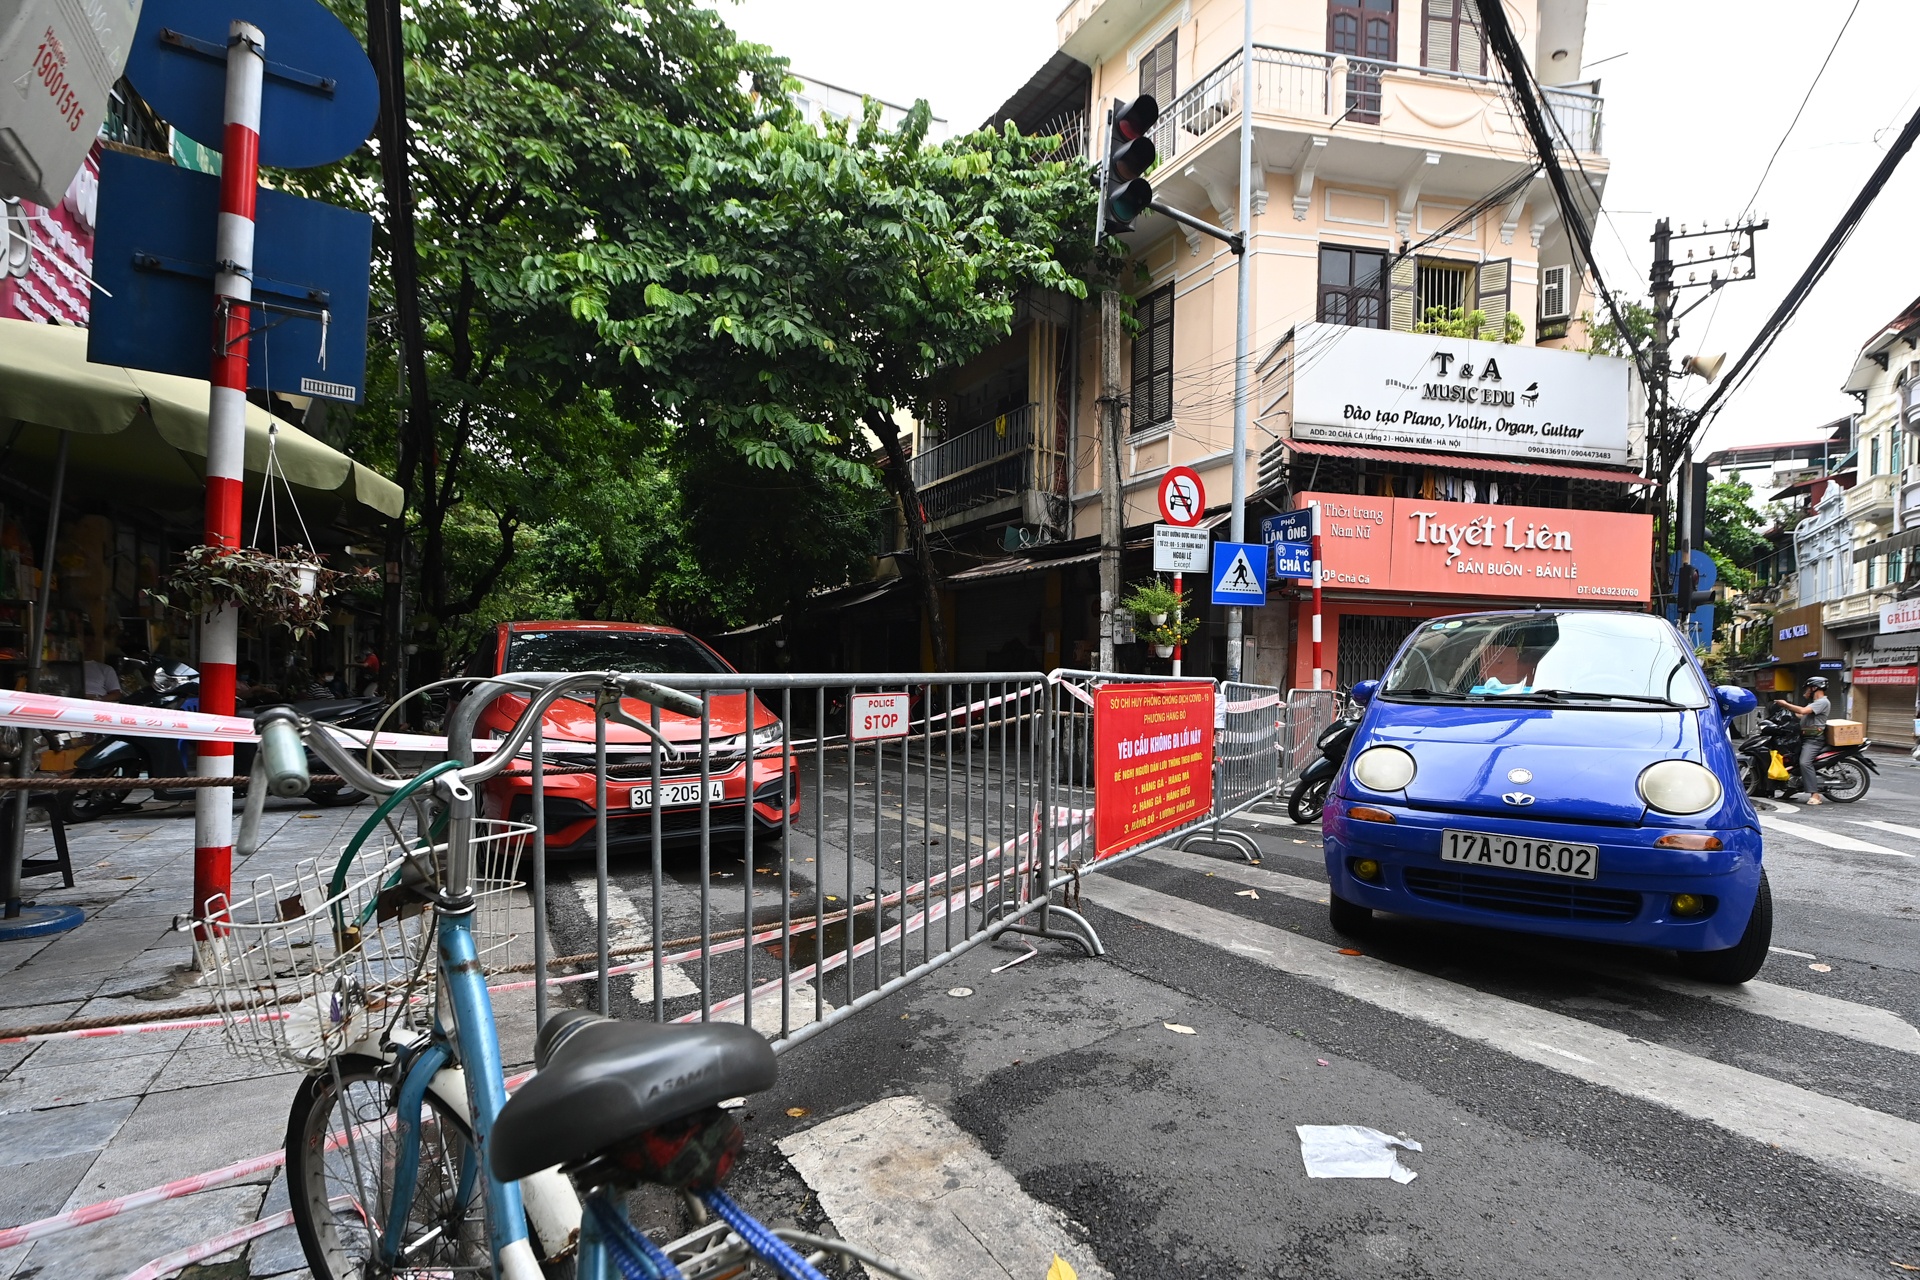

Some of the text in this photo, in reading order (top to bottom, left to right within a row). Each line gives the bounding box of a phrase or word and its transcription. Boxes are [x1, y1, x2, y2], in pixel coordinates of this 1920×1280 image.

[33, 43, 85, 131] 19001515
[1432, 351, 1502, 381] T & A
[1422, 383, 1515, 406] MUSIC EDU
[1343, 404, 1371, 421] Đào
[1376, 409, 1400, 425] tạo
[1495, 417, 1539, 437] Organ,
[1541, 422, 1584, 440] Guitar
[1309, 428, 1327, 436] ADD:
[1395, 435, 1413, 443] HOÀN
[1449, 439, 1461, 448] NỘI
[1280, 515, 1295, 526] PHỐ
[1324, 503, 1384, 525] Thời trang
[1265, 525, 1307, 544] LÃN ÔNG
[1331, 524, 1371, 539] Nam Nữ
[1409, 510, 1573, 567] Tuyết Liên
[1295, 548, 1309, 557] PHỐ
[1174, 561, 1190, 569] Except
[1280, 556, 1312, 572] CHẢ C
[1457, 558, 1484, 574] BÁN
[1487, 561, 1523, 576] BUÔN
[1536, 562, 1561, 578] BÁN
[1565, 563, 1577, 579] LẺ
[1338, 573, 1356, 583] Chả
[1358, 574, 1370, 584] Cá
[868, 699, 895, 709] POLICE
[1132, 697, 1143, 708] HUY
[1143, 694, 1161, 707] PHÒNG
[1162, 694, 1178, 705] CHỐNG
[1179, 694, 1188, 705] DỊCH
[1189, 694, 1201, 703] COVID
[864, 714, 898, 730] STOP
[1144, 711, 1165, 724] PHƯỜNG
[1166, 710, 1179, 721] HÀNG
[1118, 726, 1202, 760] YÊU CẦU KHÔNG ĐI LỐI NÀY
[1114, 768, 1121, 782] ĐỀ
[1123, 768, 1134, 780] NGHỊ
[1135, 763, 1149, 776] NGƯỜI
[1150, 761, 1159, 773] DÂN
[1168, 757, 1181, 768] THÔNG
[1181, 755, 1190, 764] THEO
[1135, 786, 1140, 796] 1.
[1141, 780, 1156, 793] HÀNG
[1157, 777, 1164, 788] GÀ
[1168, 774, 1181, 785] HÀNG
[1132, 804, 1138, 814] 2.
[1139, 798, 1153, 811] HÀNG
[1155, 794, 1162, 806] GÀ
[1166, 790, 1180, 802] HÀNG
[1124, 824, 1129, 834] 3.
[1131, 817, 1146, 831] HÀNG
[1160, 807, 1175, 820] LƯƠNG
[1186, 799, 1195, 810] CAN
[1450, 833, 1591, 876] 17A-016.02
